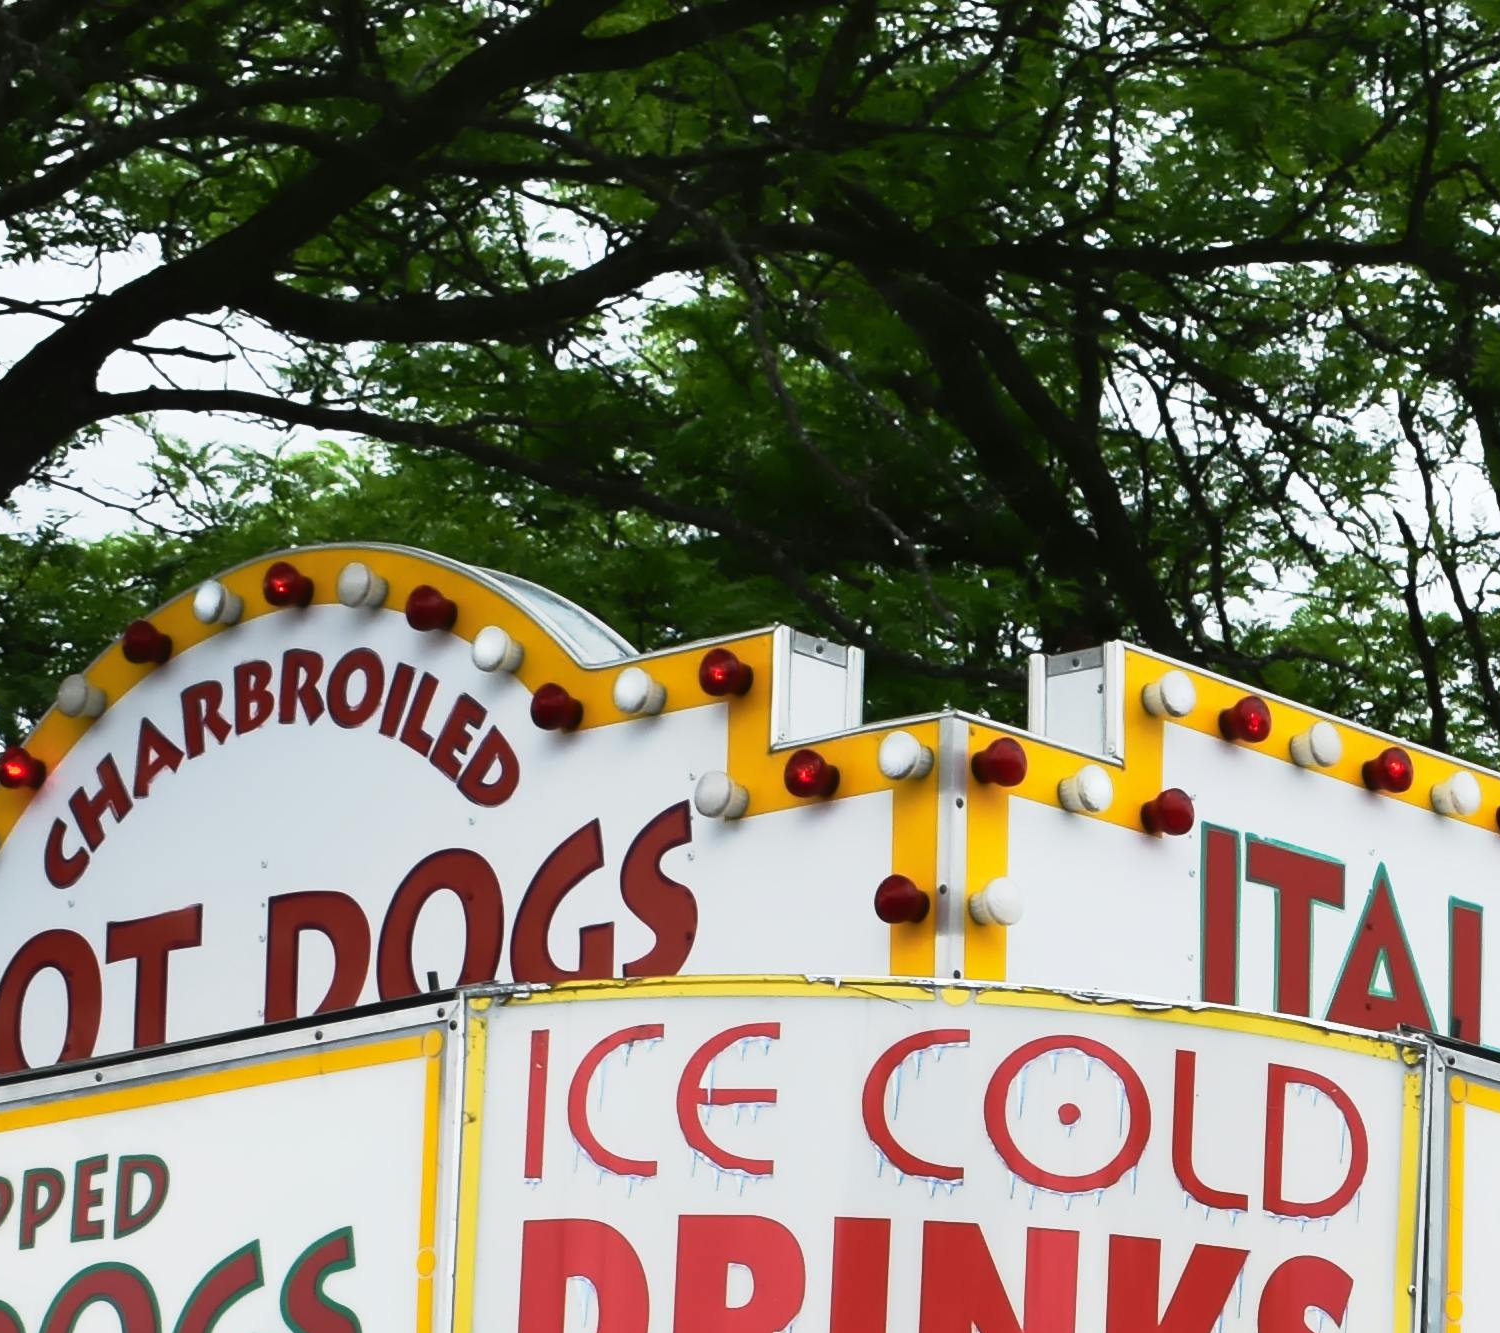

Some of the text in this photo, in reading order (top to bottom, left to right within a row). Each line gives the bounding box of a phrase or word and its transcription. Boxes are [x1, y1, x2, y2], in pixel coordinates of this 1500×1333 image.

[44, 647, 520, 890] CHARBROILED
[266, 800, 700, 1024] DOGS
[523, 1022, 1369, 1220] ICE COLD
